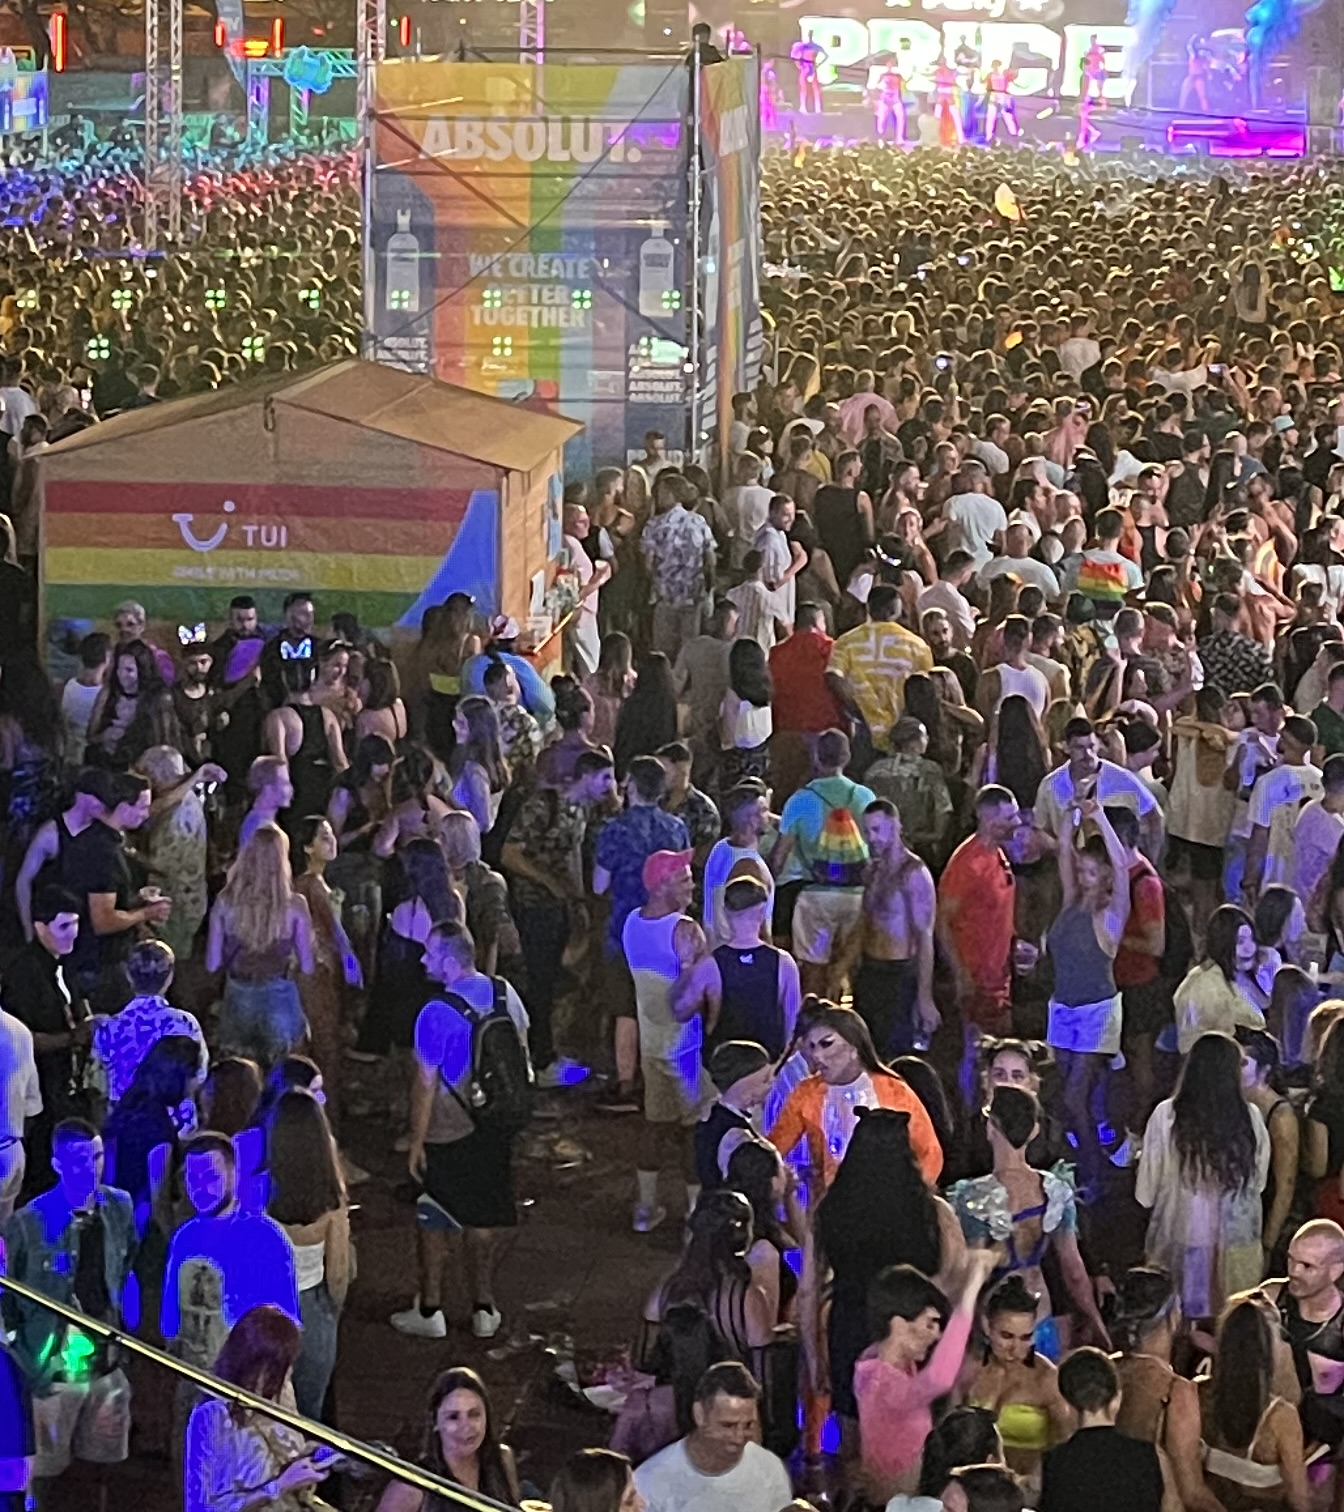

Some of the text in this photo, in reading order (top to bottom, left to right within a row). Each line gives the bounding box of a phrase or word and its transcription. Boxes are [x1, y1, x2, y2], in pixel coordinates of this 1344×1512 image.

[420, 116, 642, 163] ABSOLUT.
[469, 252, 591, 279] WE CREATE
[470, 304, 586, 328] TOGETHER
[242, 525, 287, 548] TUI
